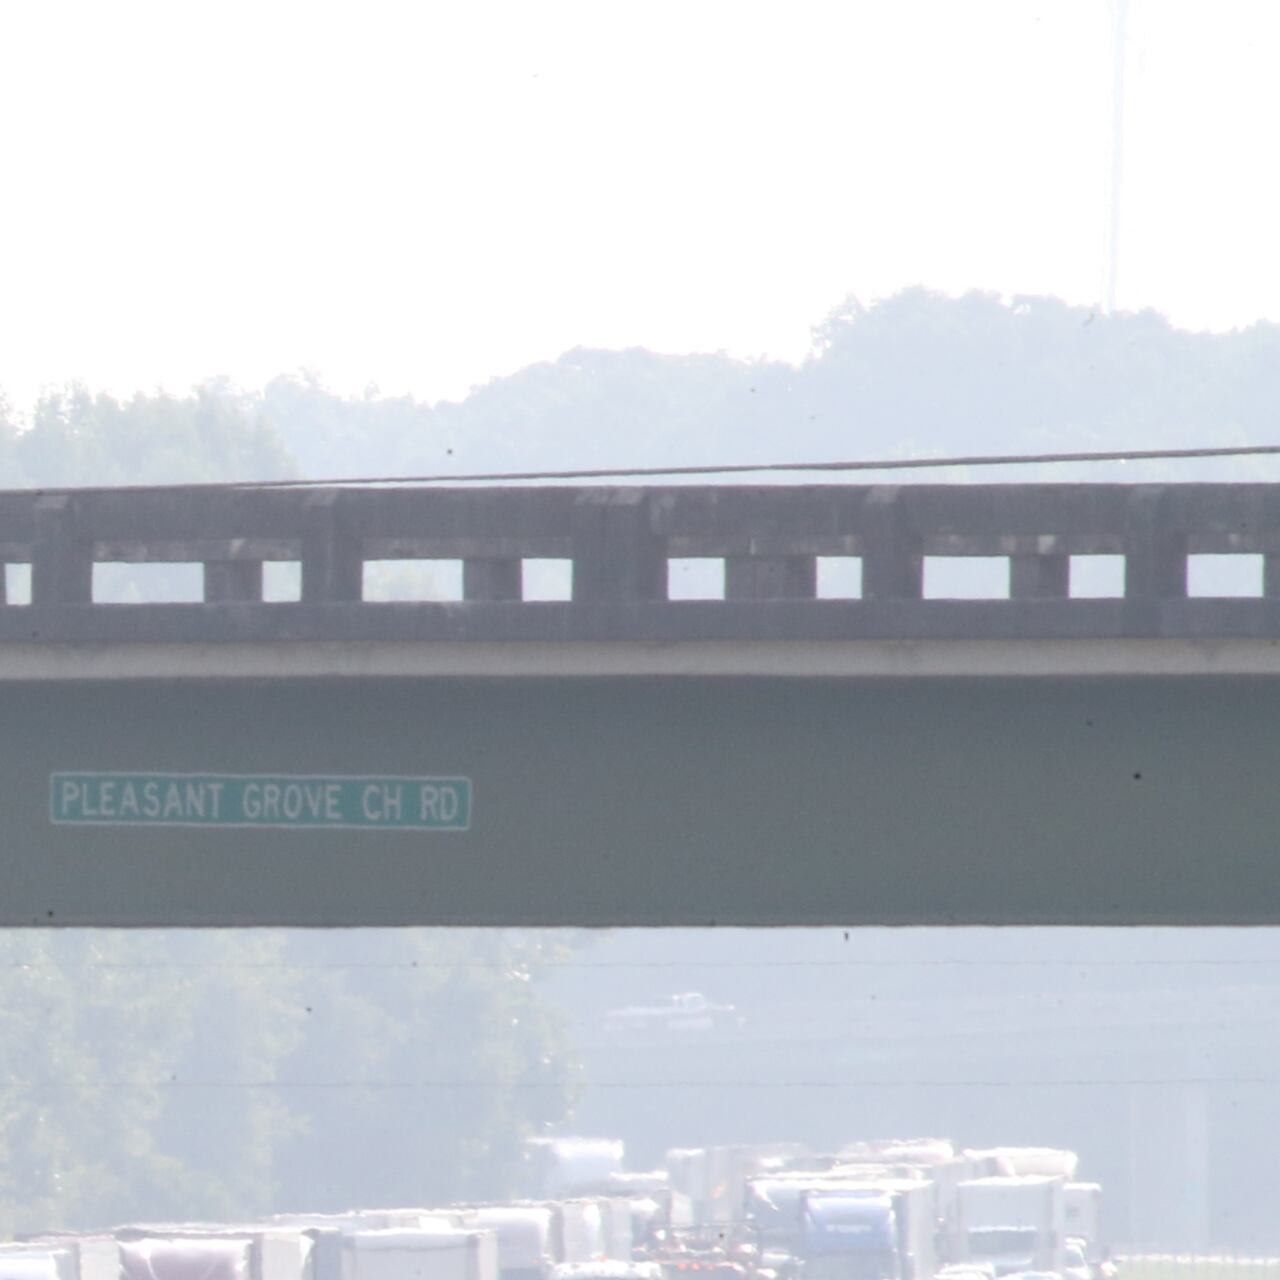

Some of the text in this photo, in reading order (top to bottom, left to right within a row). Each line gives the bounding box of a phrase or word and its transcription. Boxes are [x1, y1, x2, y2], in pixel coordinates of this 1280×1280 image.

[61, 781, 460, 822] PLEASANT GROVE CH RD
